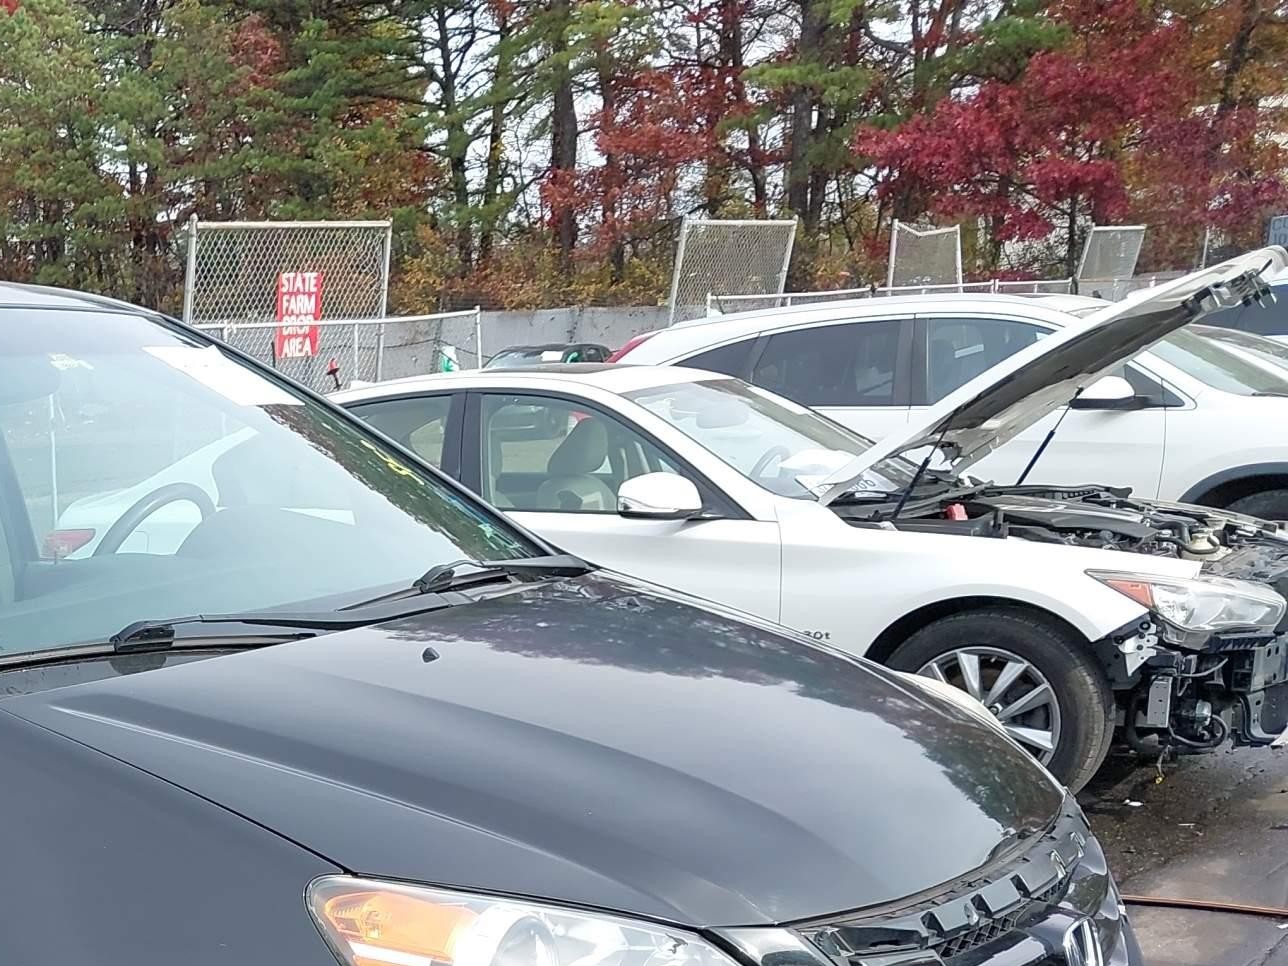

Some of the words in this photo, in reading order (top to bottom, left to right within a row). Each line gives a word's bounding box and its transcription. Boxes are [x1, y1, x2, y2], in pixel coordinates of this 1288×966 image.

[281, 272, 318, 293] STATE
[282, 293, 316, 315] FARM
[281, 336, 312, 358] AREA
